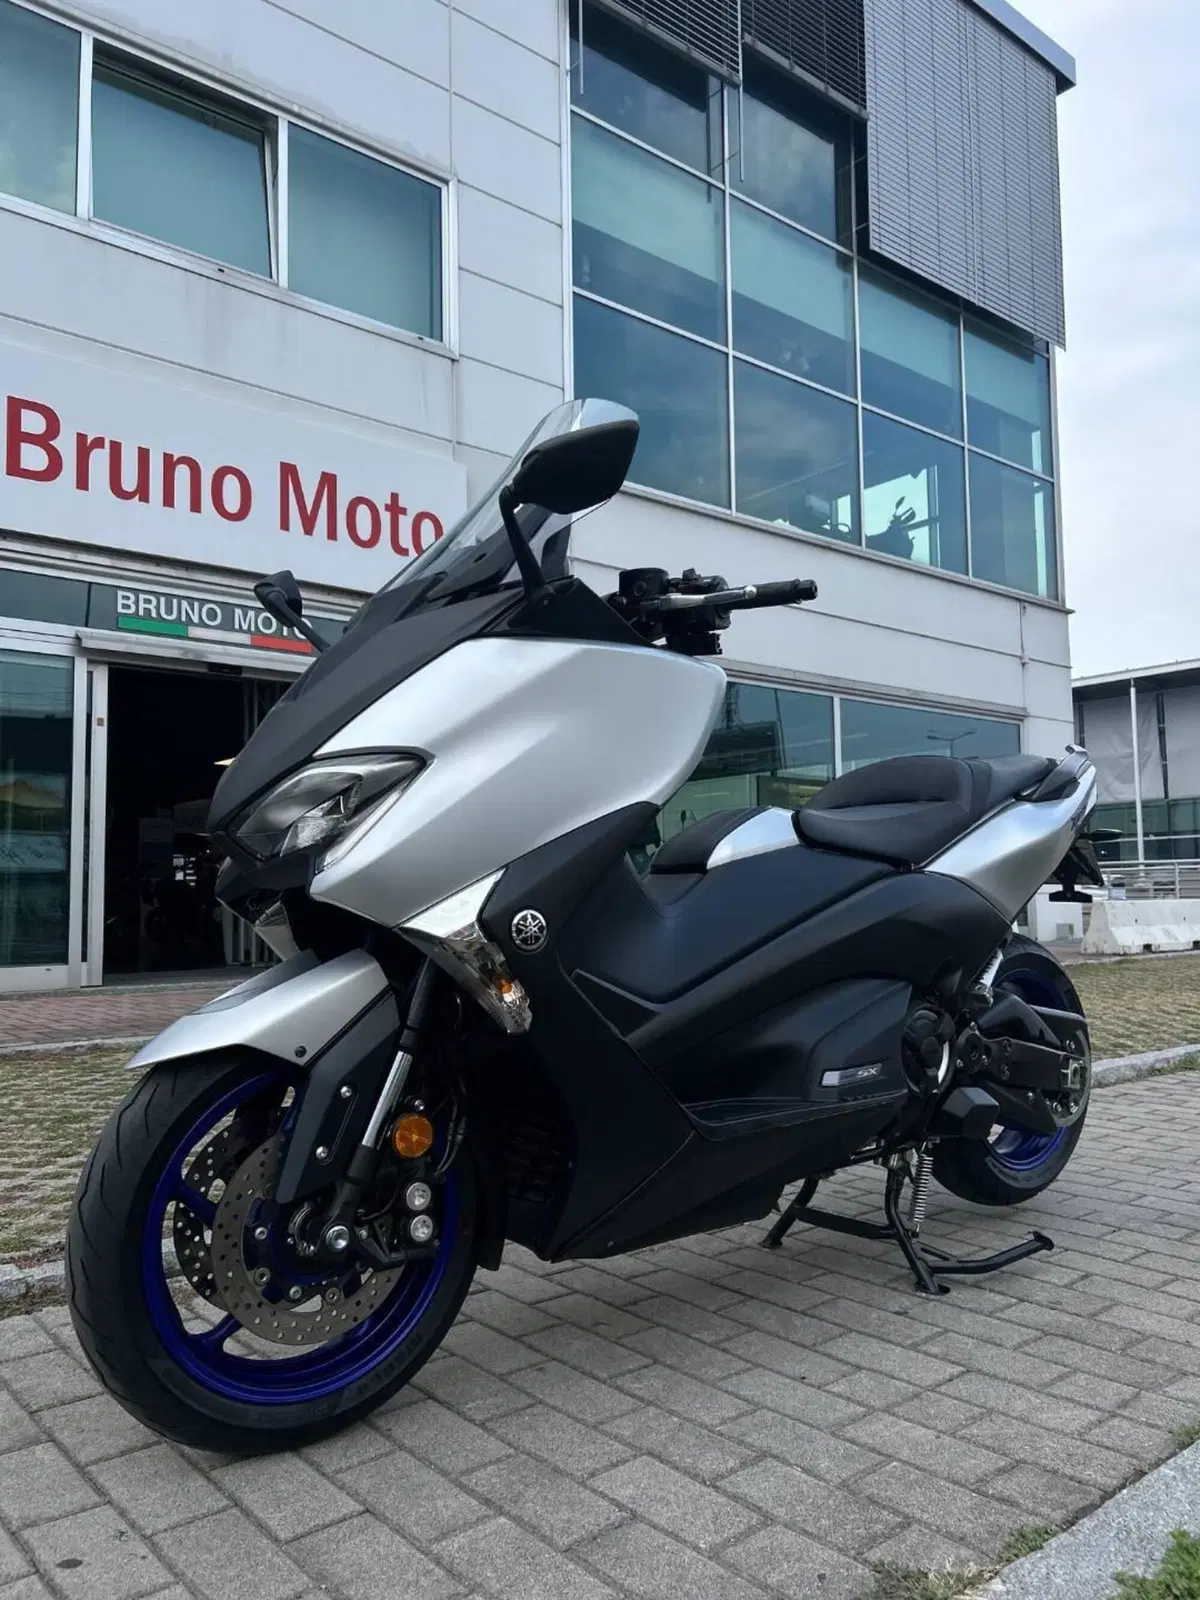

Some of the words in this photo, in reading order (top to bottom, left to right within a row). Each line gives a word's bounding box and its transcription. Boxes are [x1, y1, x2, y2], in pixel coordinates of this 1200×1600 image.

[5, 395, 252, 522] Bruno
[279, 460, 444, 557] Moto
[116, 590, 222, 626] BRUNO
